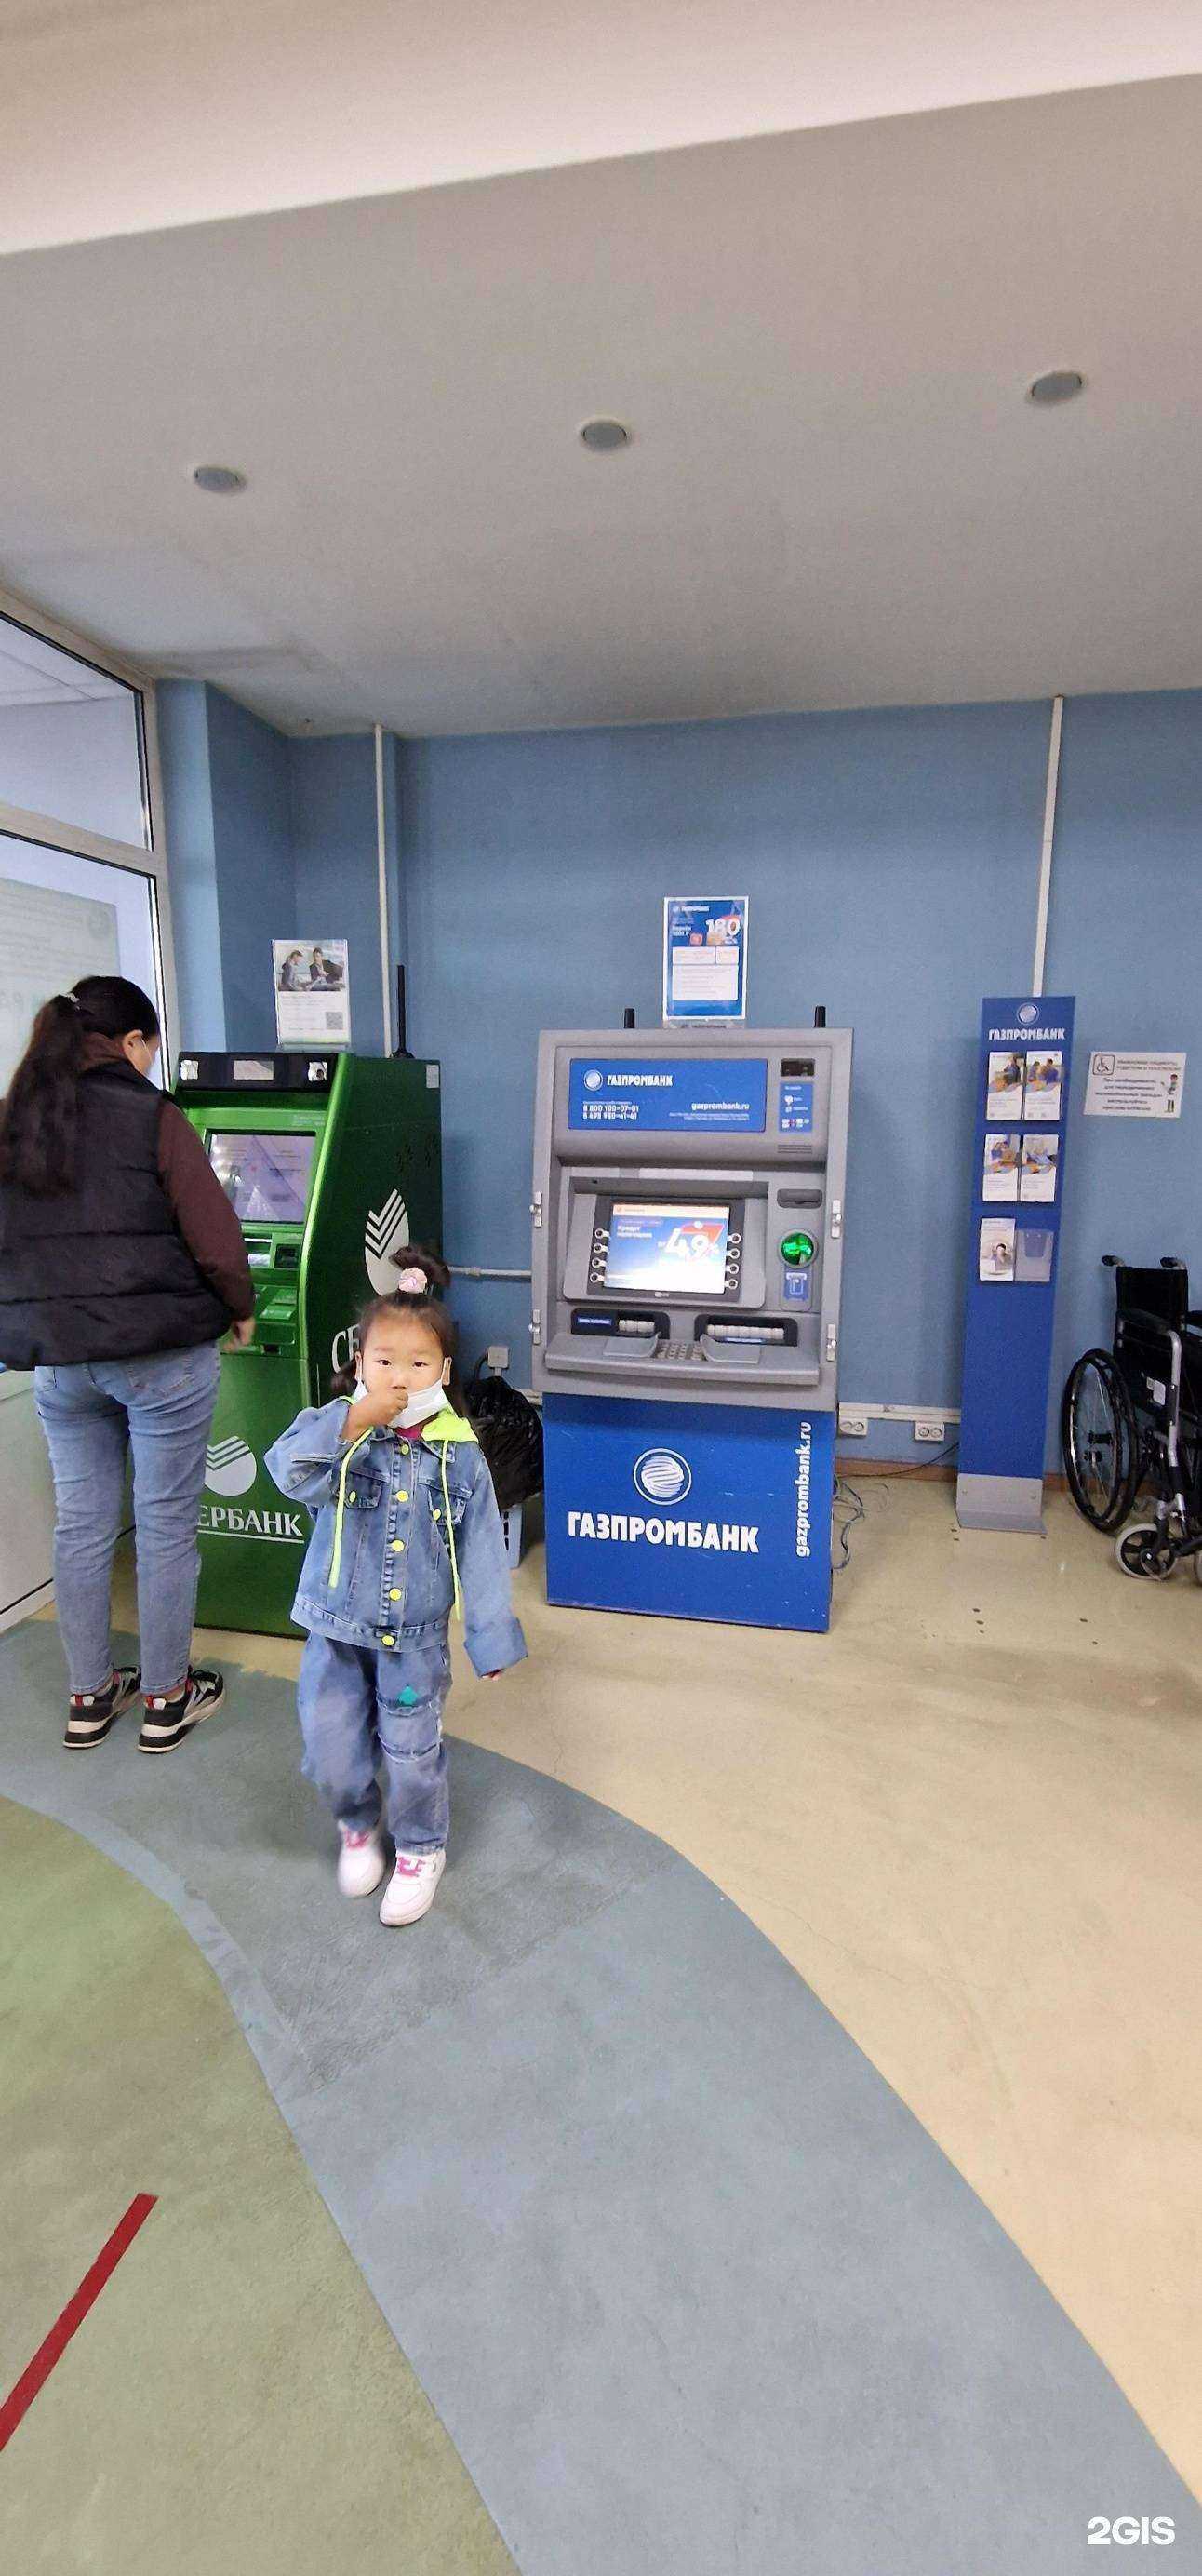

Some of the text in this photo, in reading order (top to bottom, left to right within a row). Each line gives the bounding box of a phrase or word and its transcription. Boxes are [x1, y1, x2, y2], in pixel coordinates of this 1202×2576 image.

[988, 1027, 1066, 1040] ГАЗПРОМБАНК
[607, 1074, 674, 1087] ГАЗПРОМБАНК
[691, 1102, 751, 1111] gazprombank.ru
[795, 1421, 812, 1558] gazprombank.ru
[196, 1505, 304, 1537] ЕРБАНК
[567, 1510, 760, 1554] ГАЗПРОМБАНК
